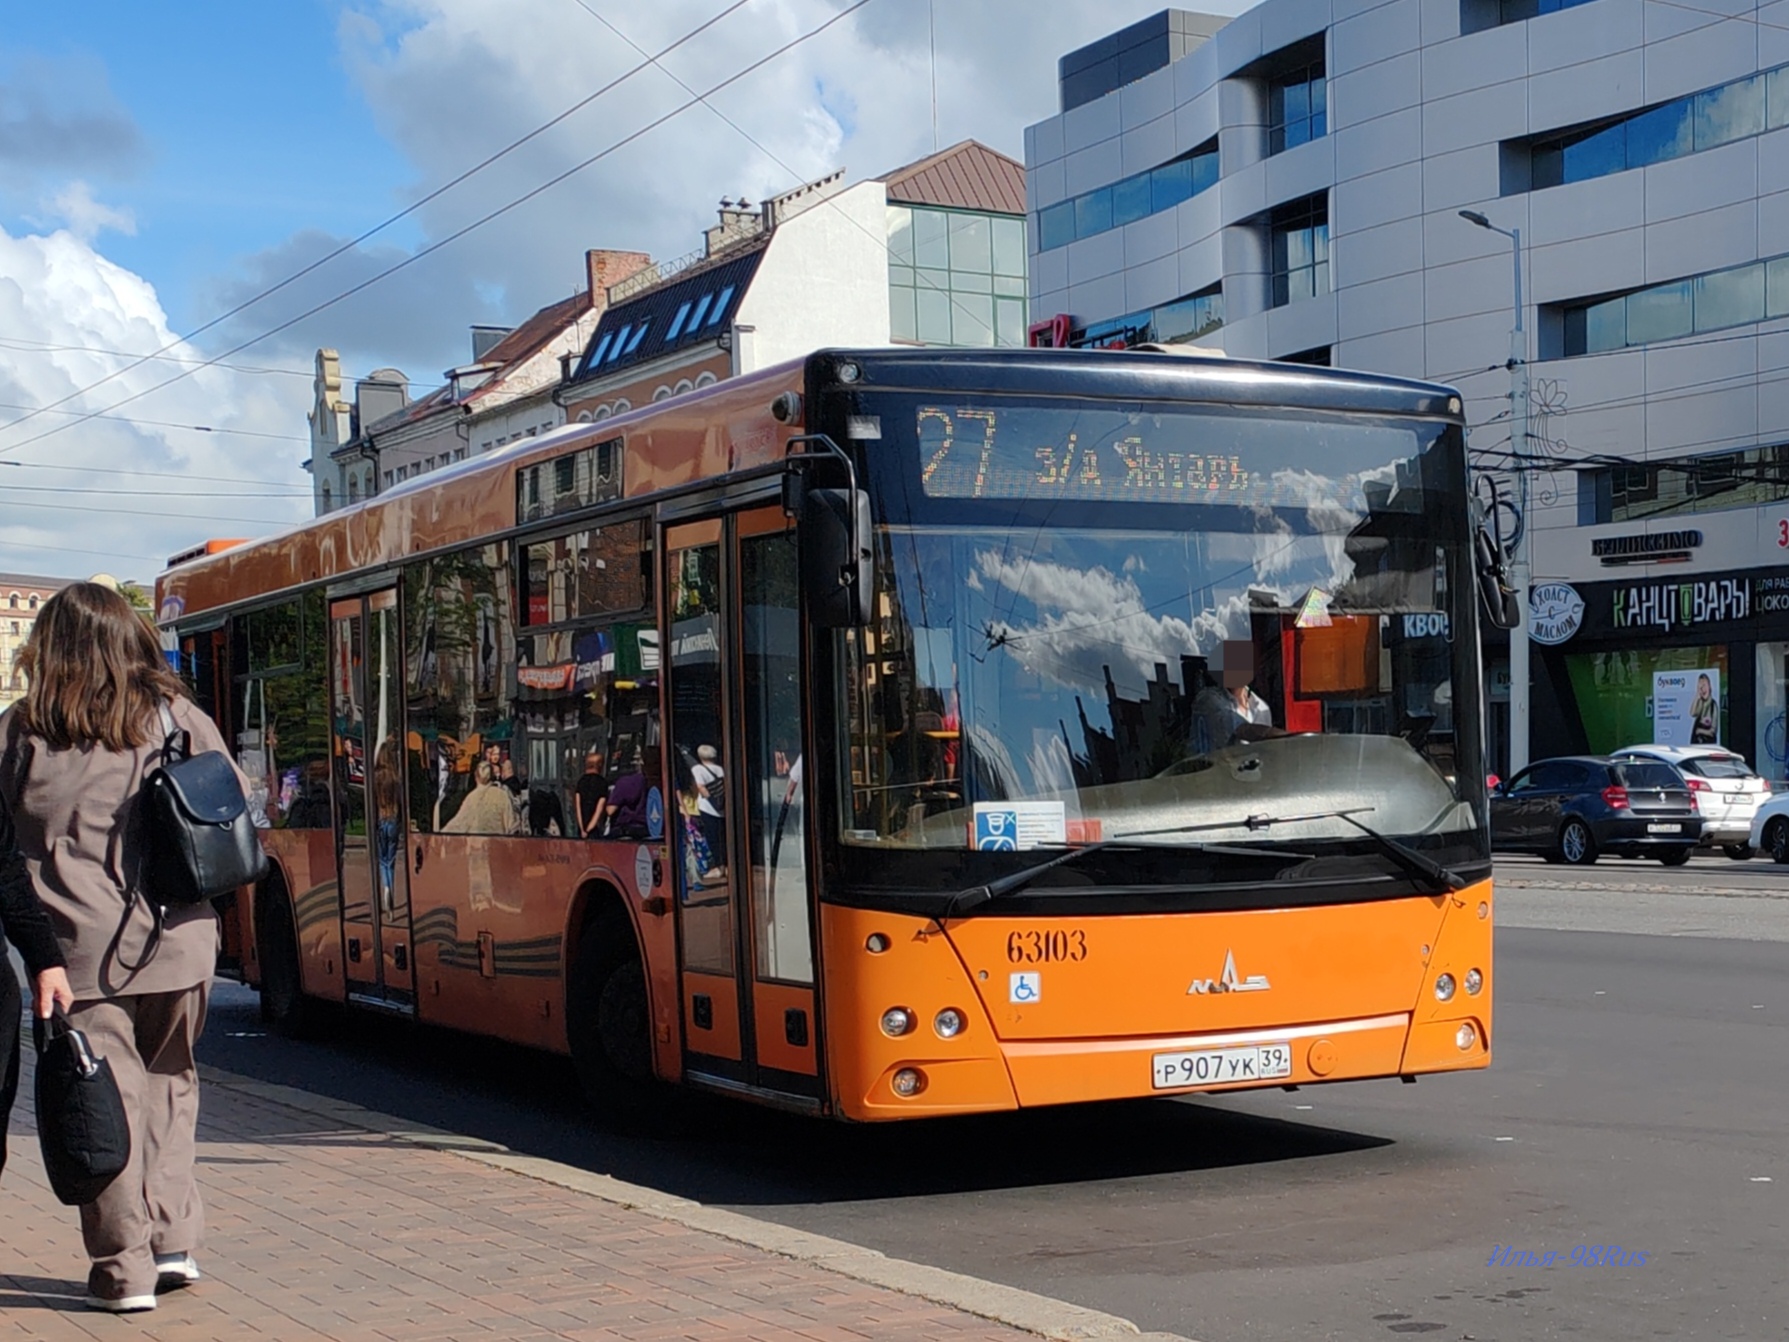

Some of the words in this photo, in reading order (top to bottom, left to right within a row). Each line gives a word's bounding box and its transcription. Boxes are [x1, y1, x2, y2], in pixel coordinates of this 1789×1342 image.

[917, 408, 995, 498] 27
[1119, 437, 1249, 491] Янтарь
[1536, 587, 1570, 606] ХОЛСТ
[1613, 579, 1750, 632] КАНЦТОВАРЫ
[1534, 614, 1577, 639] МАСЛОМ
[1007, 929, 1088, 964] 63103
[1261, 1049, 1283, 1067] 39
